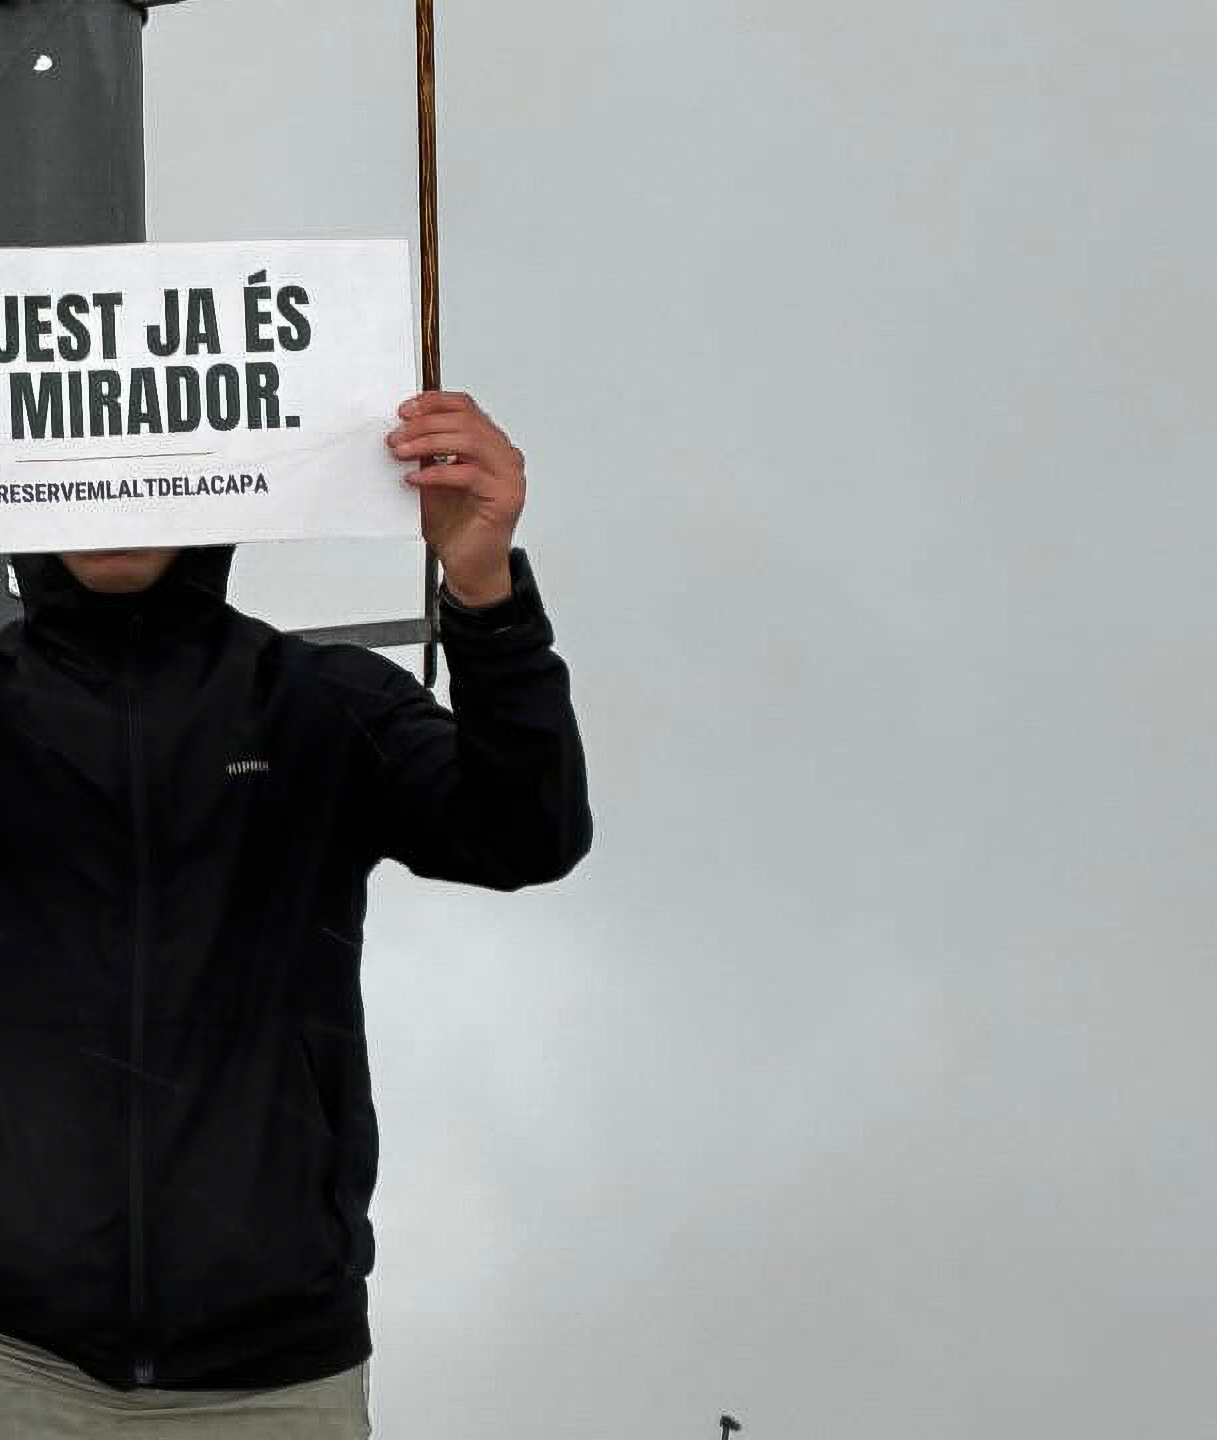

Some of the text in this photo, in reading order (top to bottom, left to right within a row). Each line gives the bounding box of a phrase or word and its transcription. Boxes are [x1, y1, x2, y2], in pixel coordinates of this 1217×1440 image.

[146, 287, 222, 357] JA
[243, 269, 312, 353] ÉS
[9, 361, 301, 441] MIRADOR.
